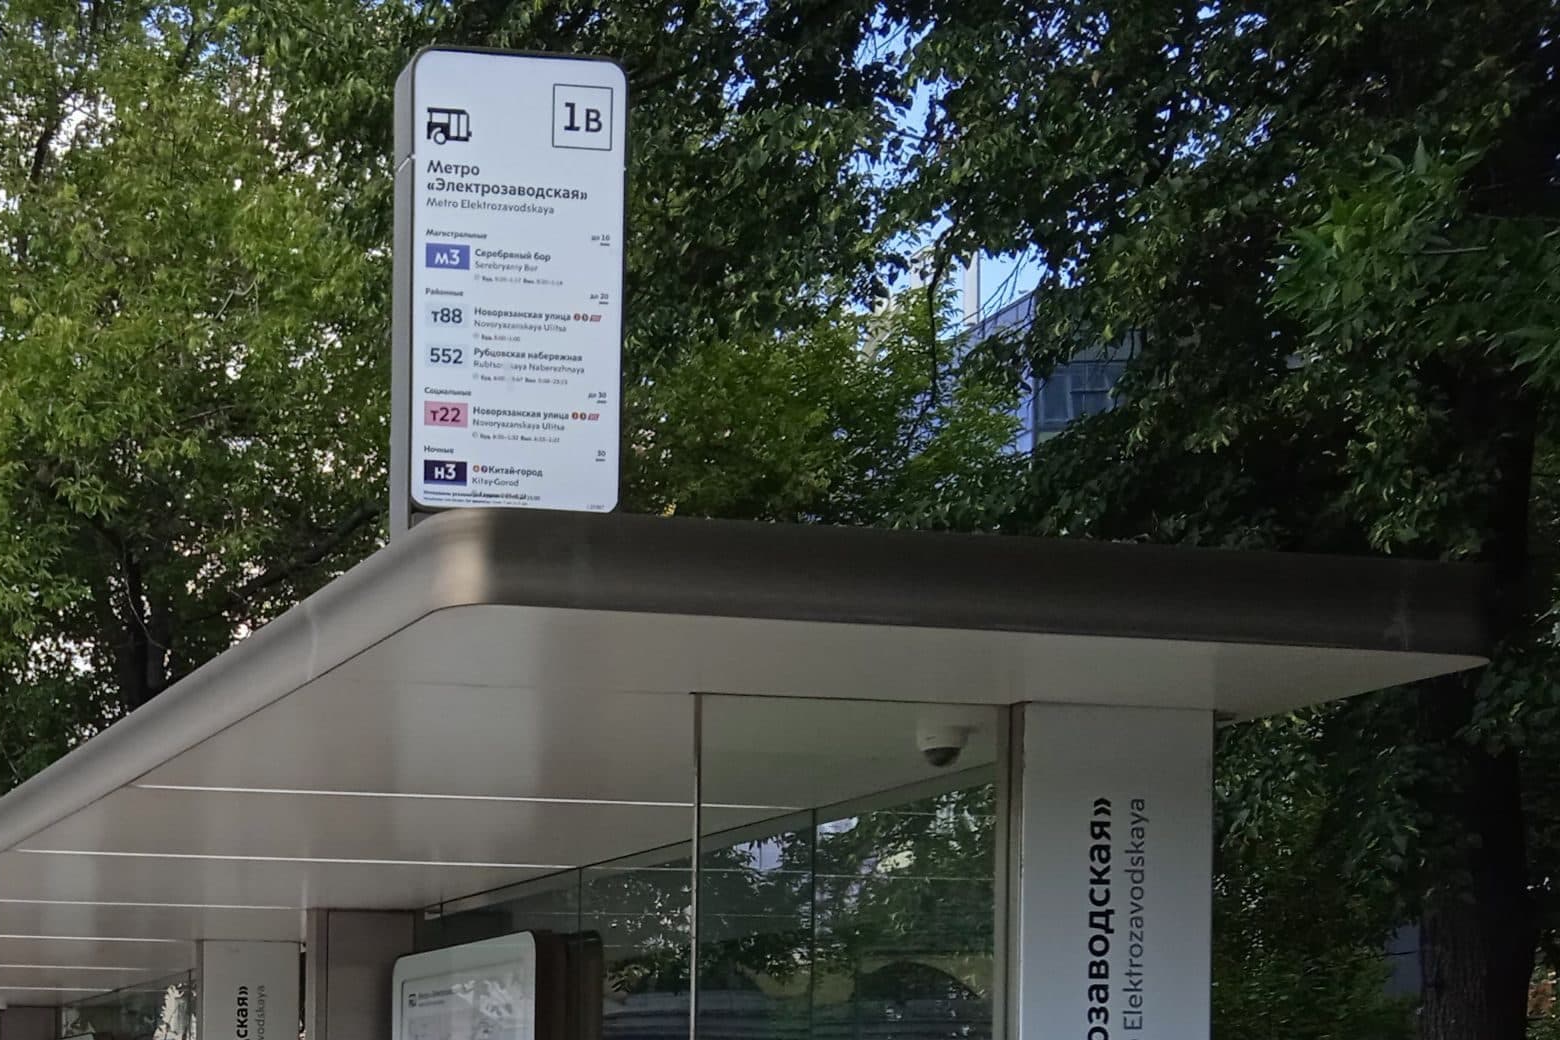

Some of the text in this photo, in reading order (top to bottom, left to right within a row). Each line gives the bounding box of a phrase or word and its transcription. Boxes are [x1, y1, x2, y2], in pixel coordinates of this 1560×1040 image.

[427, 160, 480, 178] Метро
[427, 178, 588, 200] «Электрозаводская»
[426, 198, 555, 215] Metro Elektrozavodskaya
[426, 229, 487, 240] Магистральные
[475, 248, 551, 263] Серебряный бор
[425, 287, 464, 297] Районные
[474, 307, 543, 320] Новорязанская
[544, 312, 571, 322] улица
[474, 320, 567, 332] Novoryazanskaya Ulitsa
[430, 347, 463, 364] 552
[473, 347, 583, 362] Рубцовская набережная
[528, 363, 585, 375] Naberezhnaya
[424, 386, 472, 396] Социальные
[473, 406, 541, 419] Новорязанская
[543, 411, 569, 421] улица
[473, 418, 565, 431] Novoryazanskaya Ulitsa
[424, 445, 454, 454] Ночные
[488, 465, 543, 478] Китай-город
[472, 477, 519, 487] Kitay-Gorod
[1123, 797, 1150, 1031] Elektrozavodskaya
